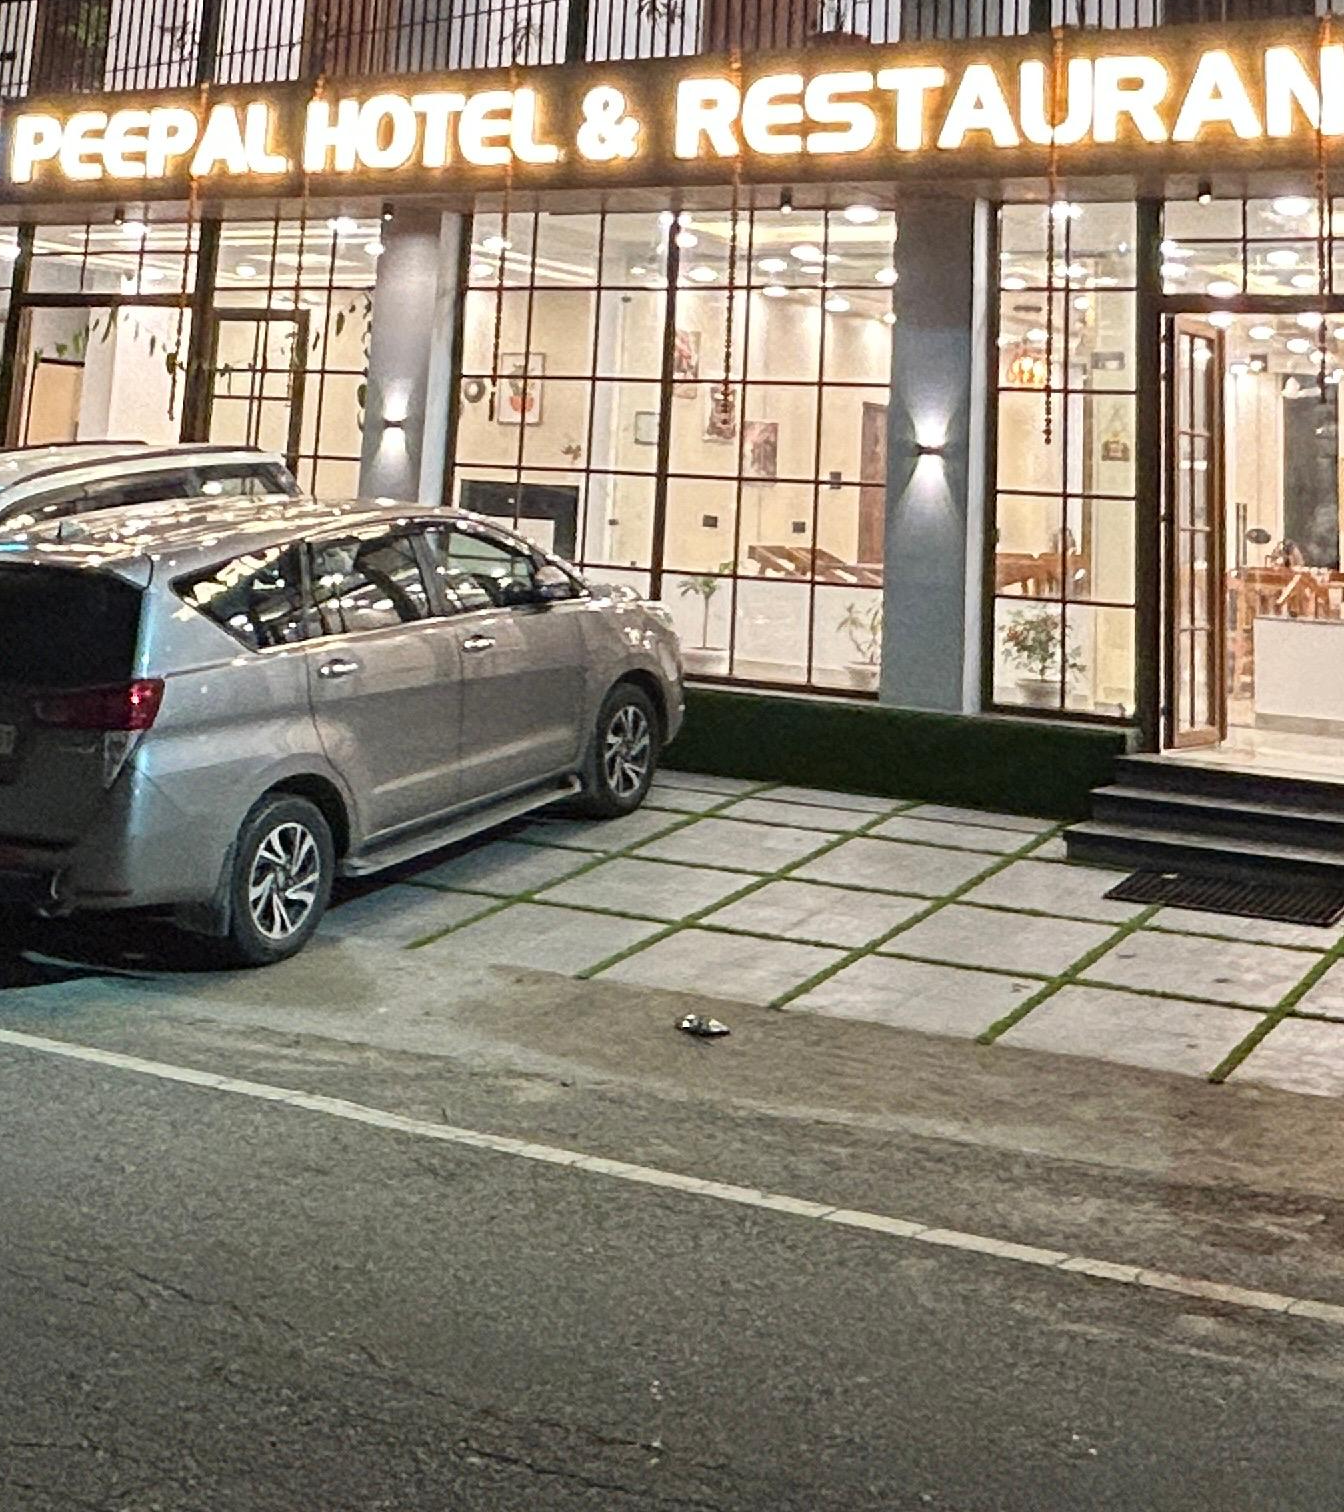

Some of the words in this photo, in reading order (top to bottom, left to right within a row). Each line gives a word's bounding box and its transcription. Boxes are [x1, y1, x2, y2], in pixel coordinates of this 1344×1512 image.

[10, 103, 290, 184] PEEPAL
[304, 88, 562, 174] HOTEL
[577, 87, 640, 161] &
